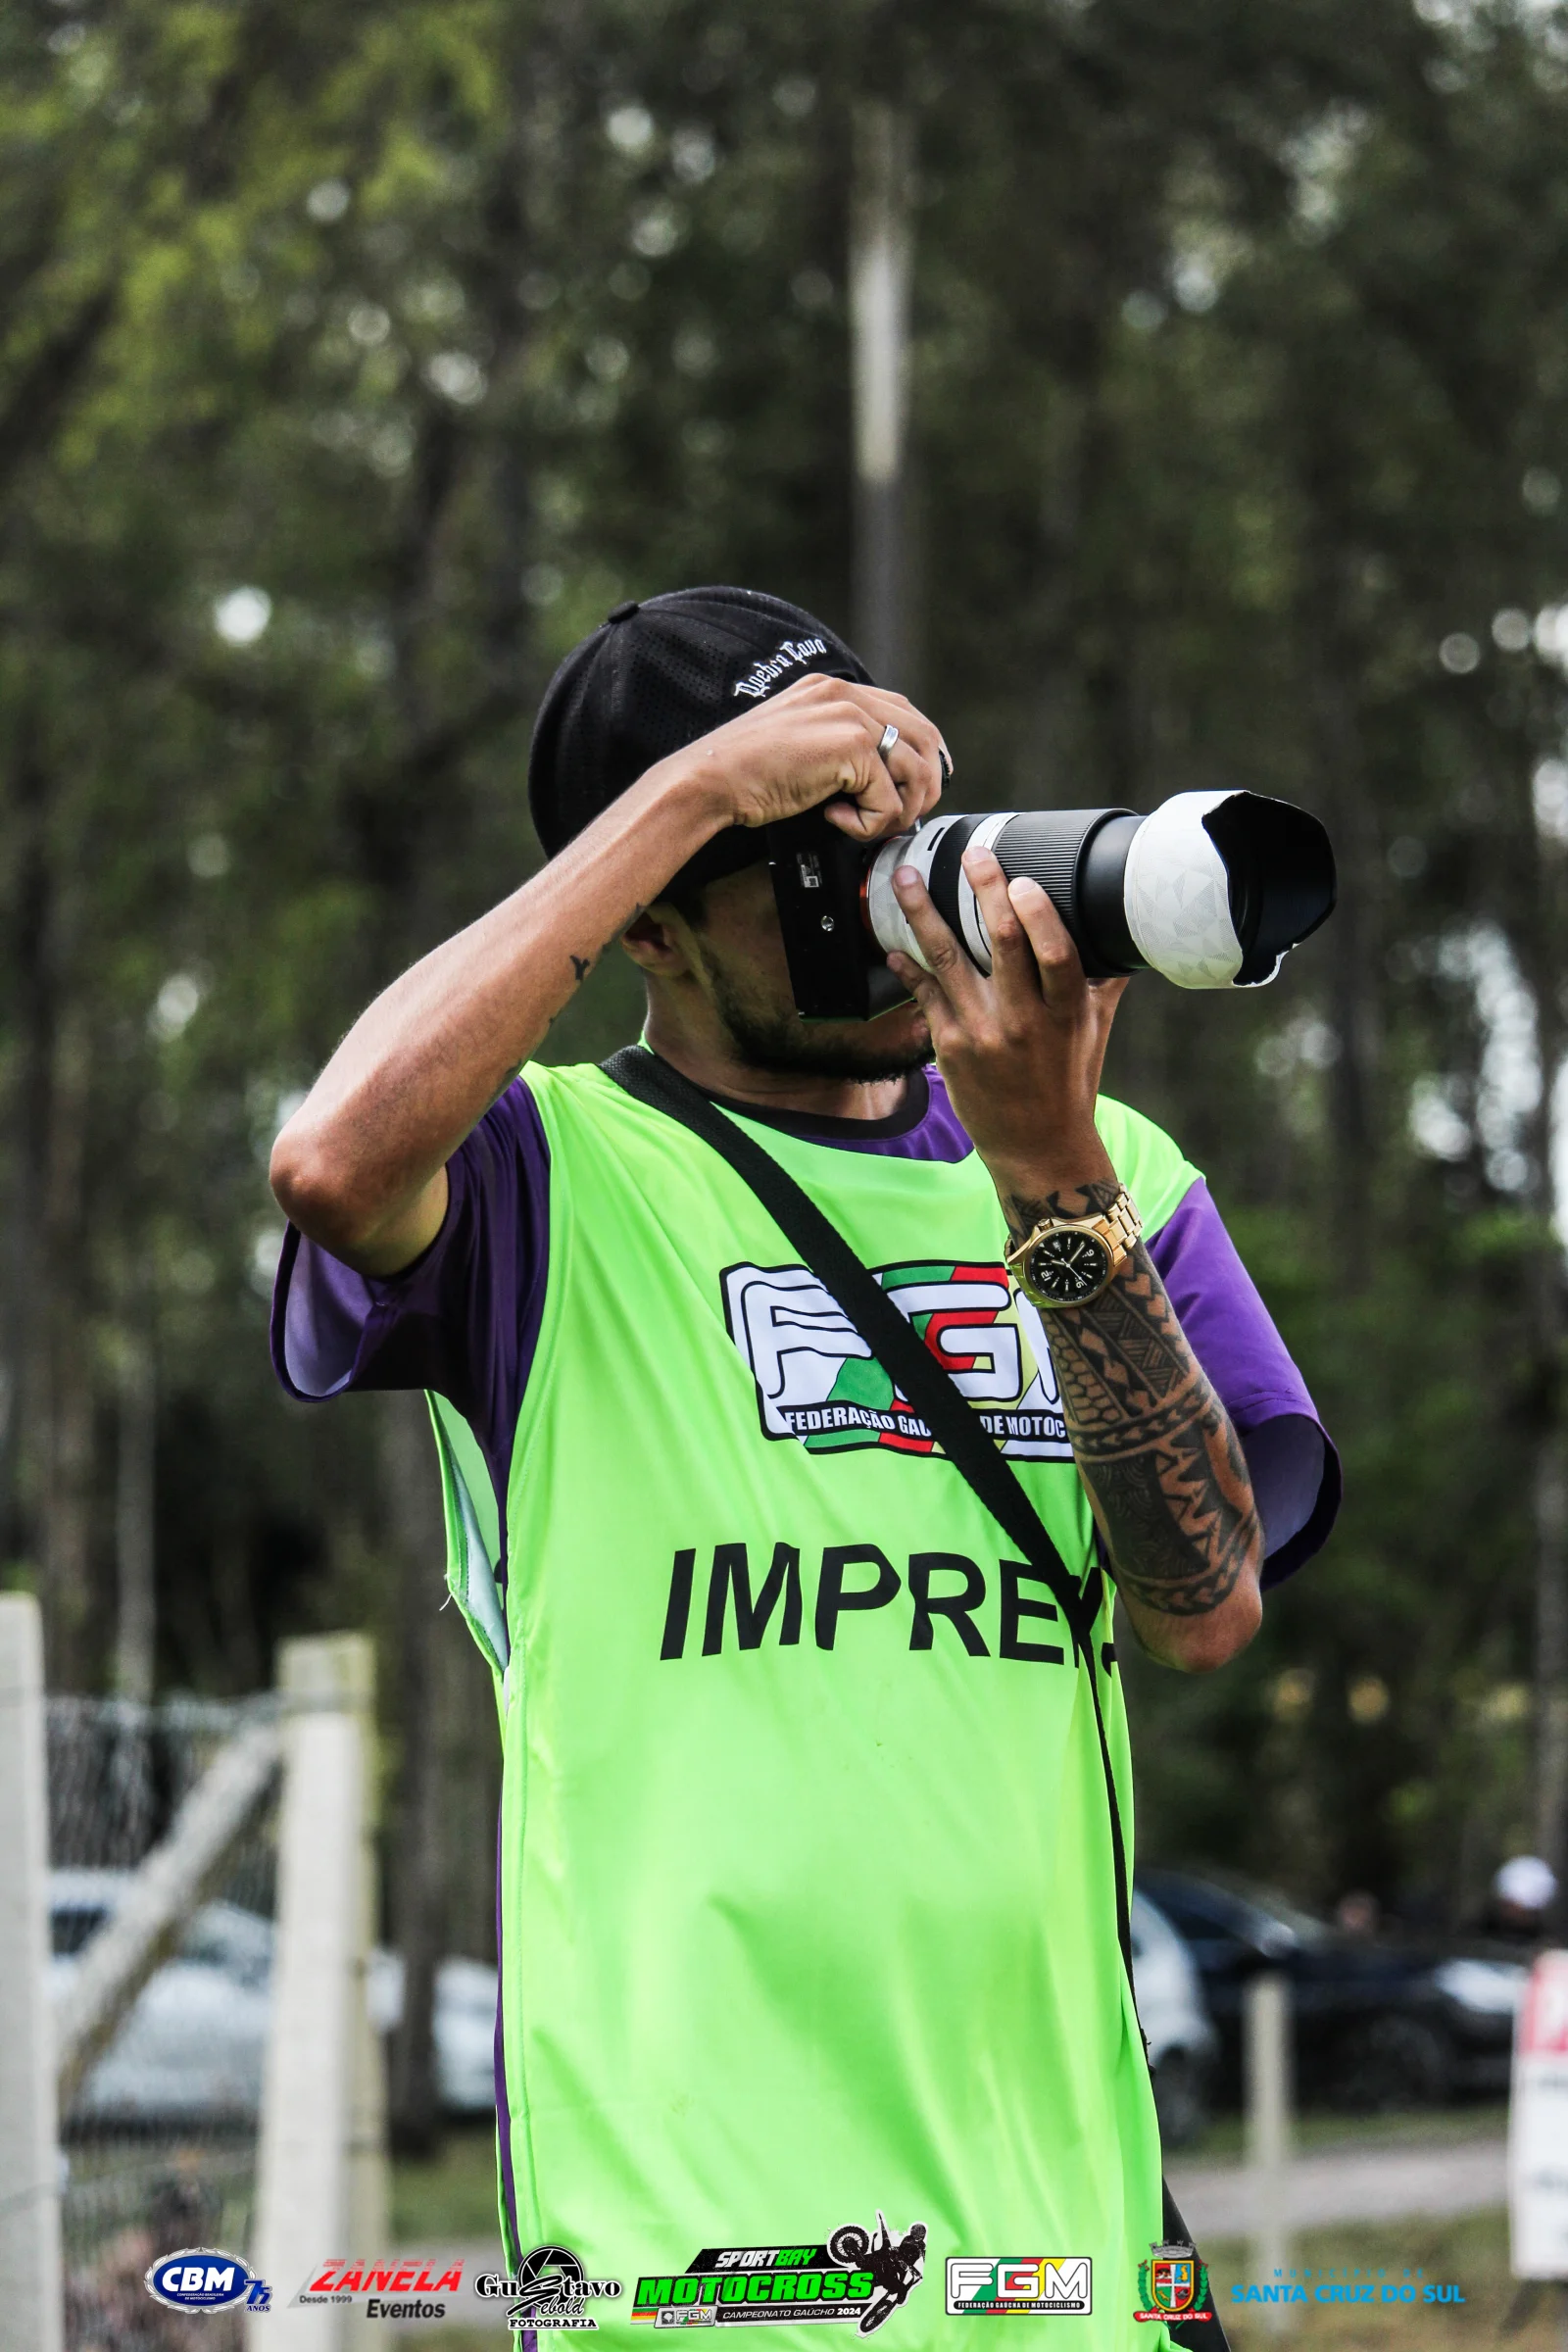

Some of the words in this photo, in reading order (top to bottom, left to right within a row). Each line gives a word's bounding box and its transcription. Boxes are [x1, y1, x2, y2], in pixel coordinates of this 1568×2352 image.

[785, 1405, 896, 1431] FEDERAÇÃO
[1005, 1416, 1067, 1438] MOTOC
[660, 1542, 1117, 1678] IMPRE
